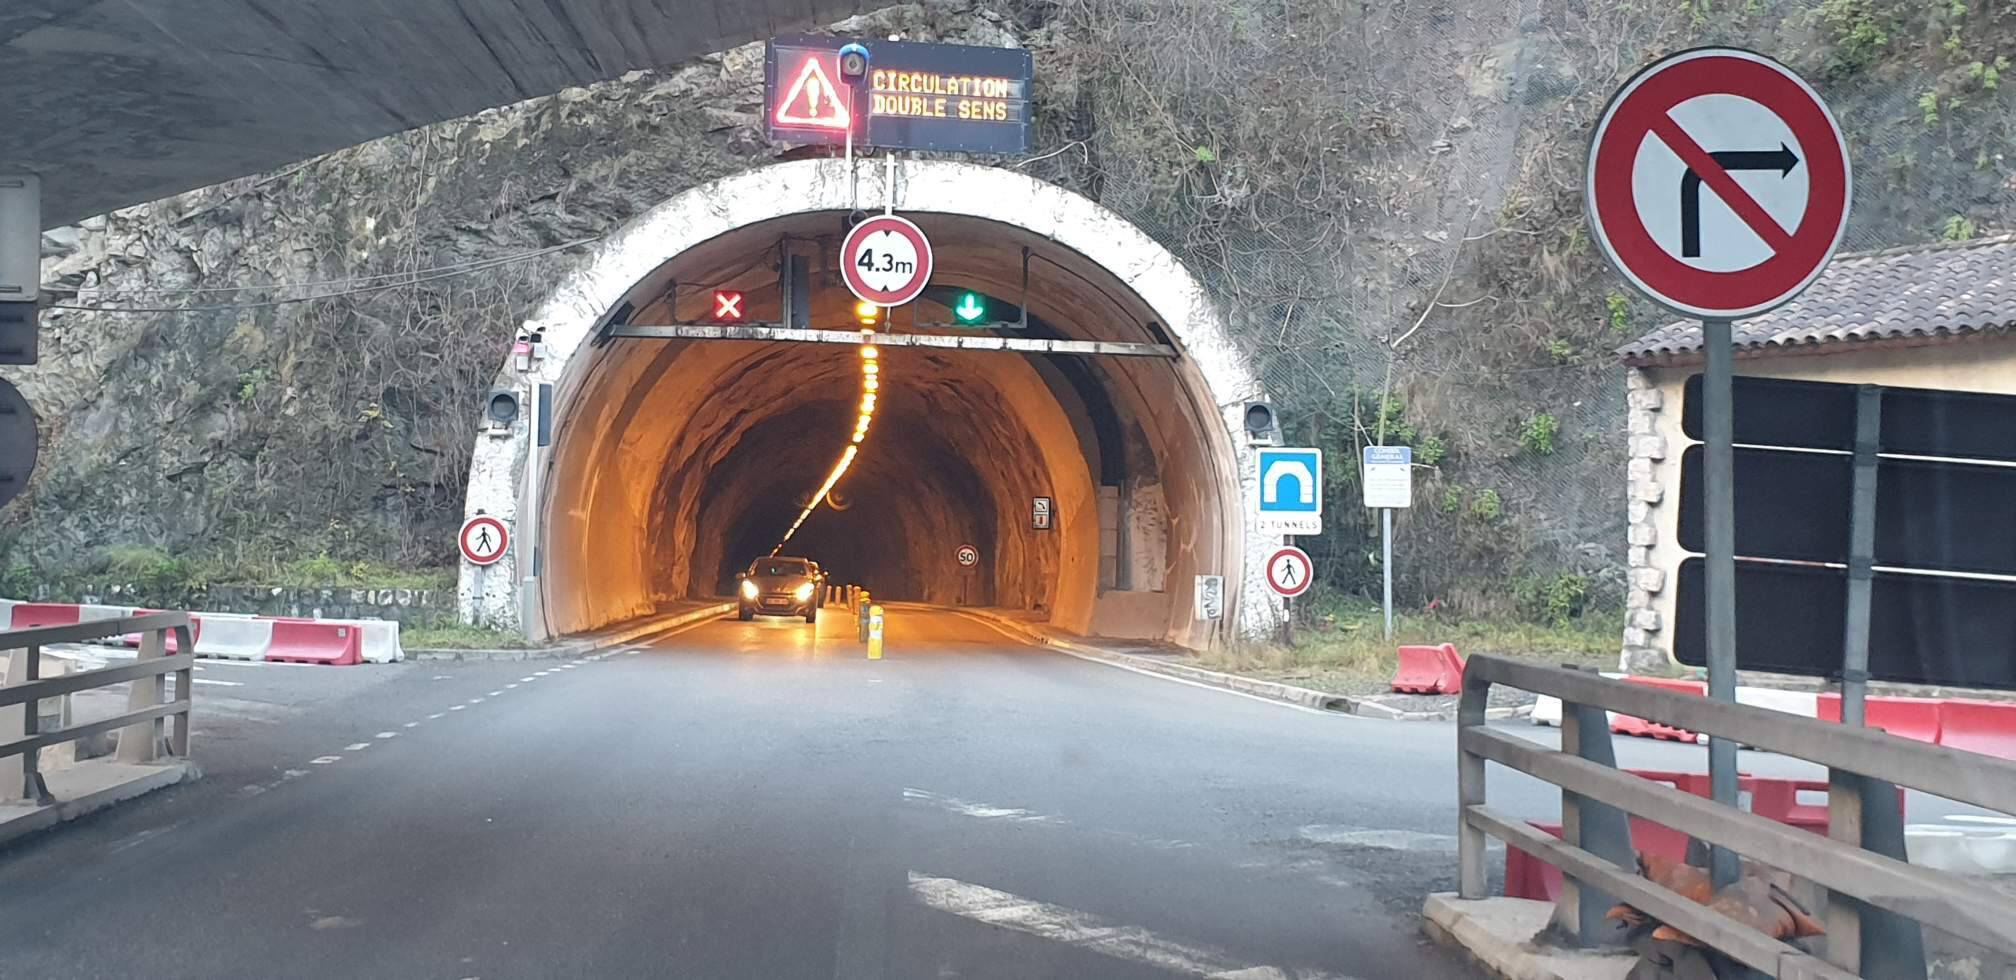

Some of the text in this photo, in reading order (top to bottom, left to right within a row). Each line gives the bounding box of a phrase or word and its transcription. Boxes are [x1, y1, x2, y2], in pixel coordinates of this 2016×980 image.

[872, 69, 1008, 98] CIRCULATION
[872, 94, 1007, 121] DOUBLE SENS
[857, 248, 913, 274] 4.3m
[1260, 519, 1318, 529] 2 TUNNELS
[960, 552, 974, 562] 50
